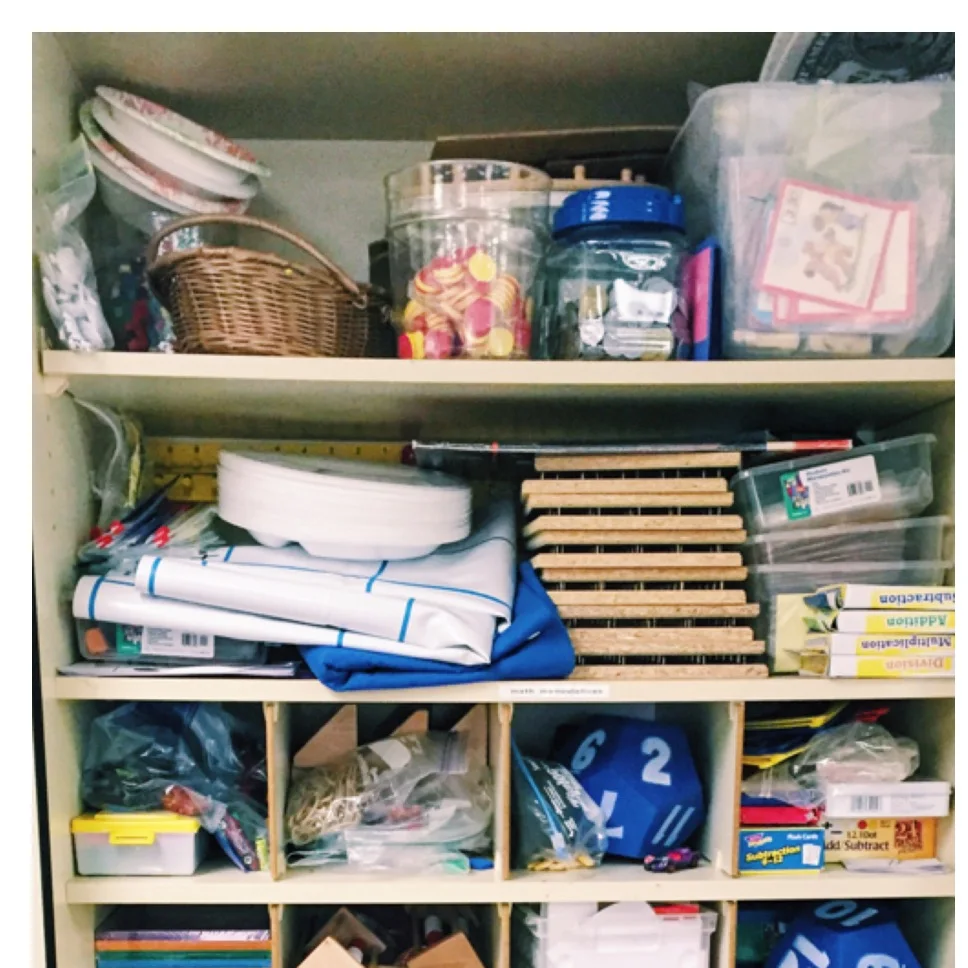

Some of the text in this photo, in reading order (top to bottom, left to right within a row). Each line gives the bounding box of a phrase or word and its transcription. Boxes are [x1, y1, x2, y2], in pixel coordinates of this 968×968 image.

[886, 614, 947, 628] Addition
[861, 634, 952, 651] Multiplication
[885, 657, 944, 670] Division
[641, 736, 672, 786] 2
[844, 840, 890, 852] Subtract
